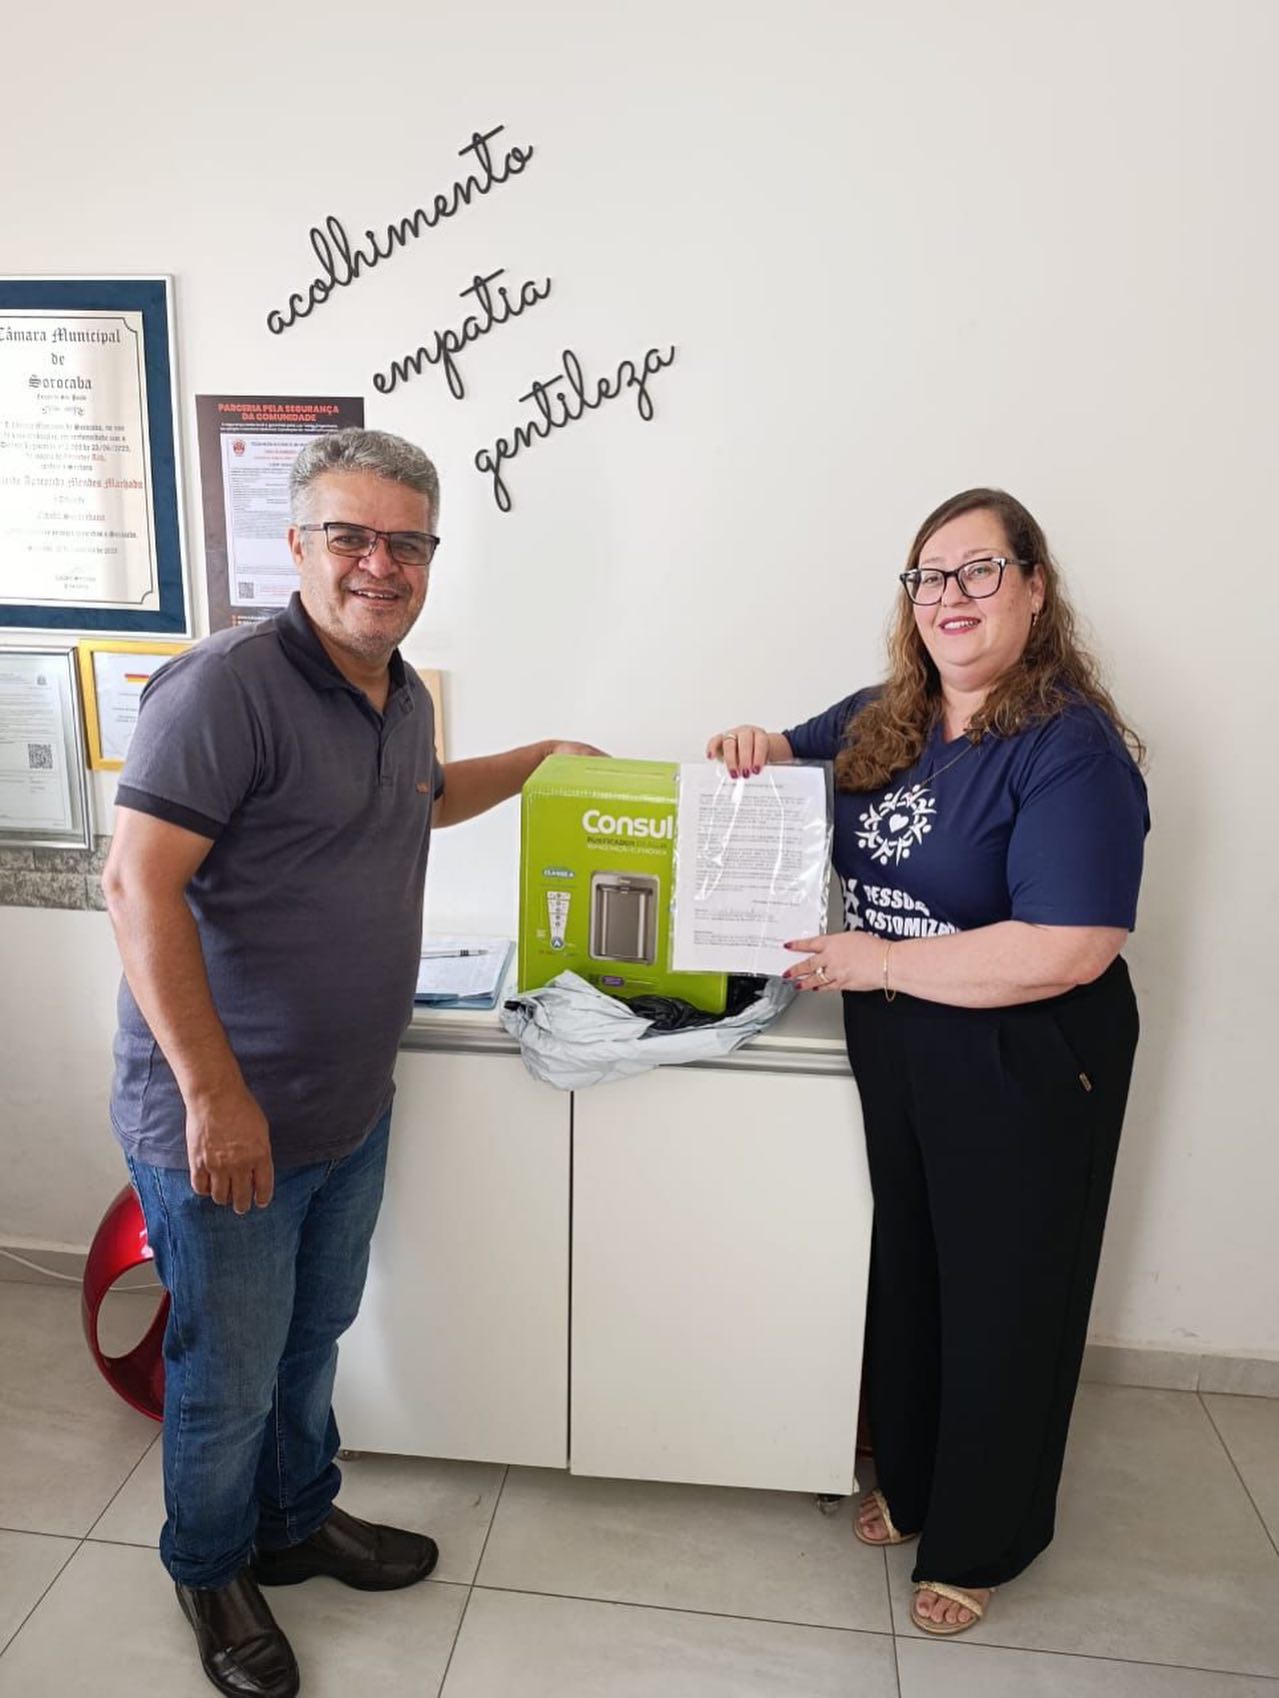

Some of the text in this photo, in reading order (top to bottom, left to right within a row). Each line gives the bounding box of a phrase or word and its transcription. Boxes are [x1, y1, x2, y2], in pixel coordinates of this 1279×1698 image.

[267, 125, 533, 335] acolhimento
[52, 327, 121, 344] Municipal
[373, 269, 552, 400] empatia
[51, 352, 65, 366] de
[28, 374, 92, 389] Sorocaba
[218, 403, 339, 415] PARCERIA PELA SEGURANÇA
[242, 412, 316, 422] DA COMUNIDADE
[475, 346, 675, 513] gentileza
[582, 809, 674, 840] Consul
